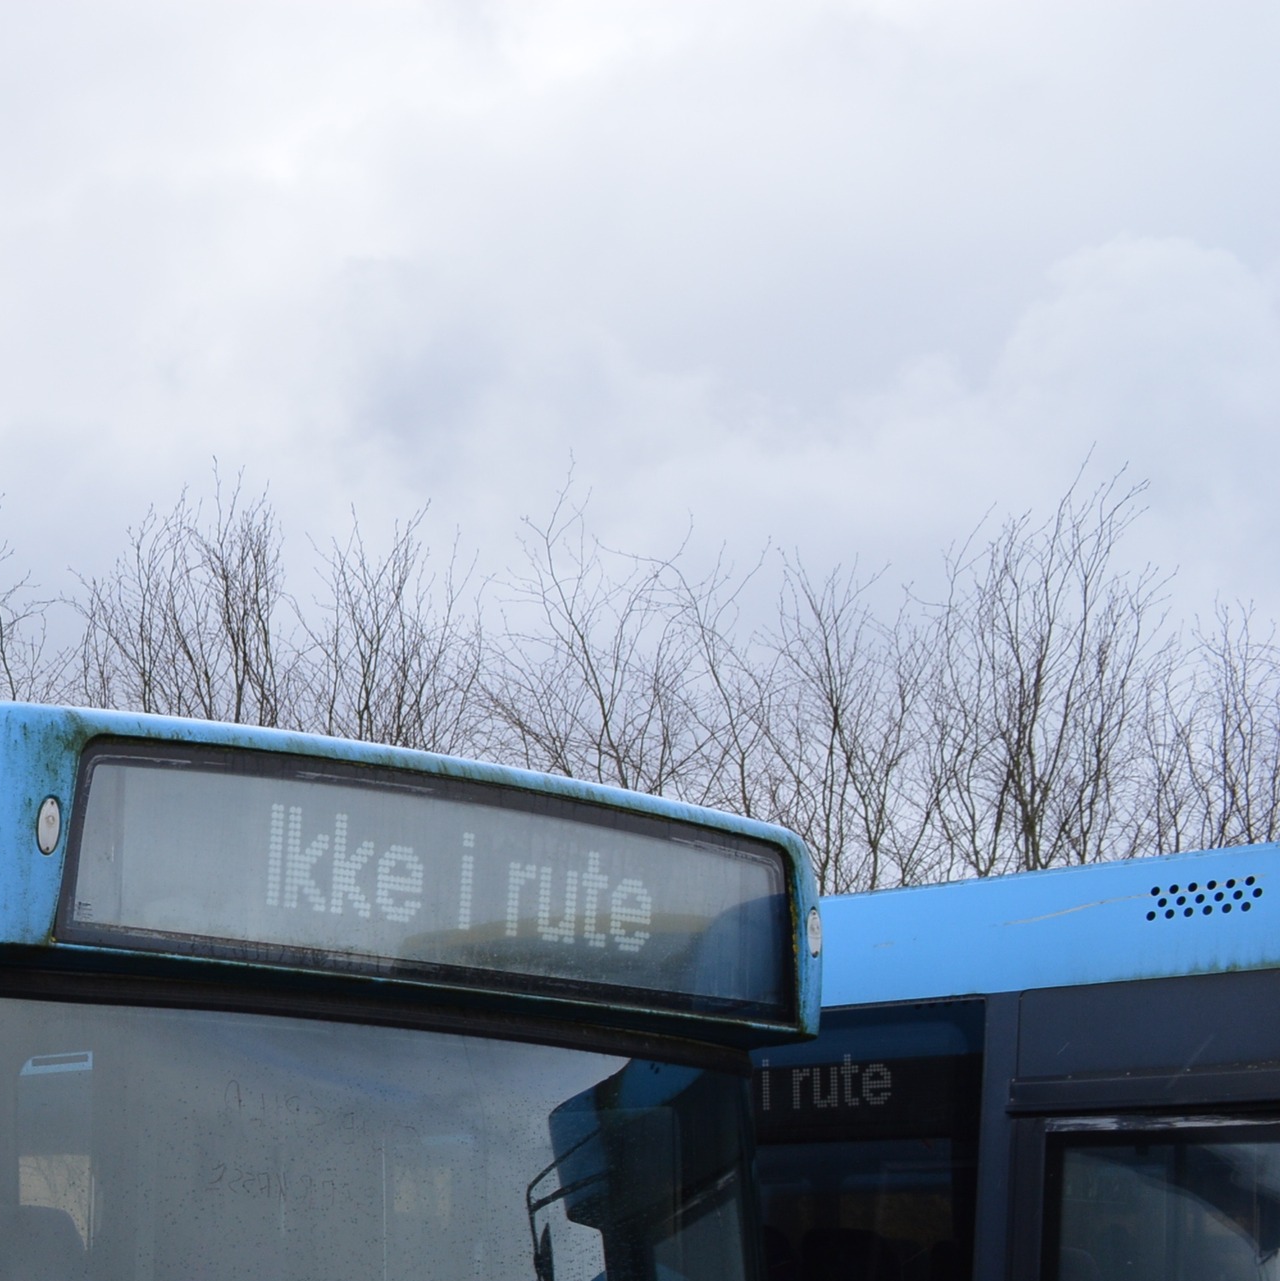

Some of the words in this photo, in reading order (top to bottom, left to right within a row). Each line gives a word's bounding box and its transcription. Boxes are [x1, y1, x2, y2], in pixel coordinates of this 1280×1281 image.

[266, 803, 423, 922] Ikke
[459, 832, 475, 930] i
[506, 851, 652, 952] rute
[762, 1059, 770, 1110] i
[792, 1054, 891, 1109] rute
